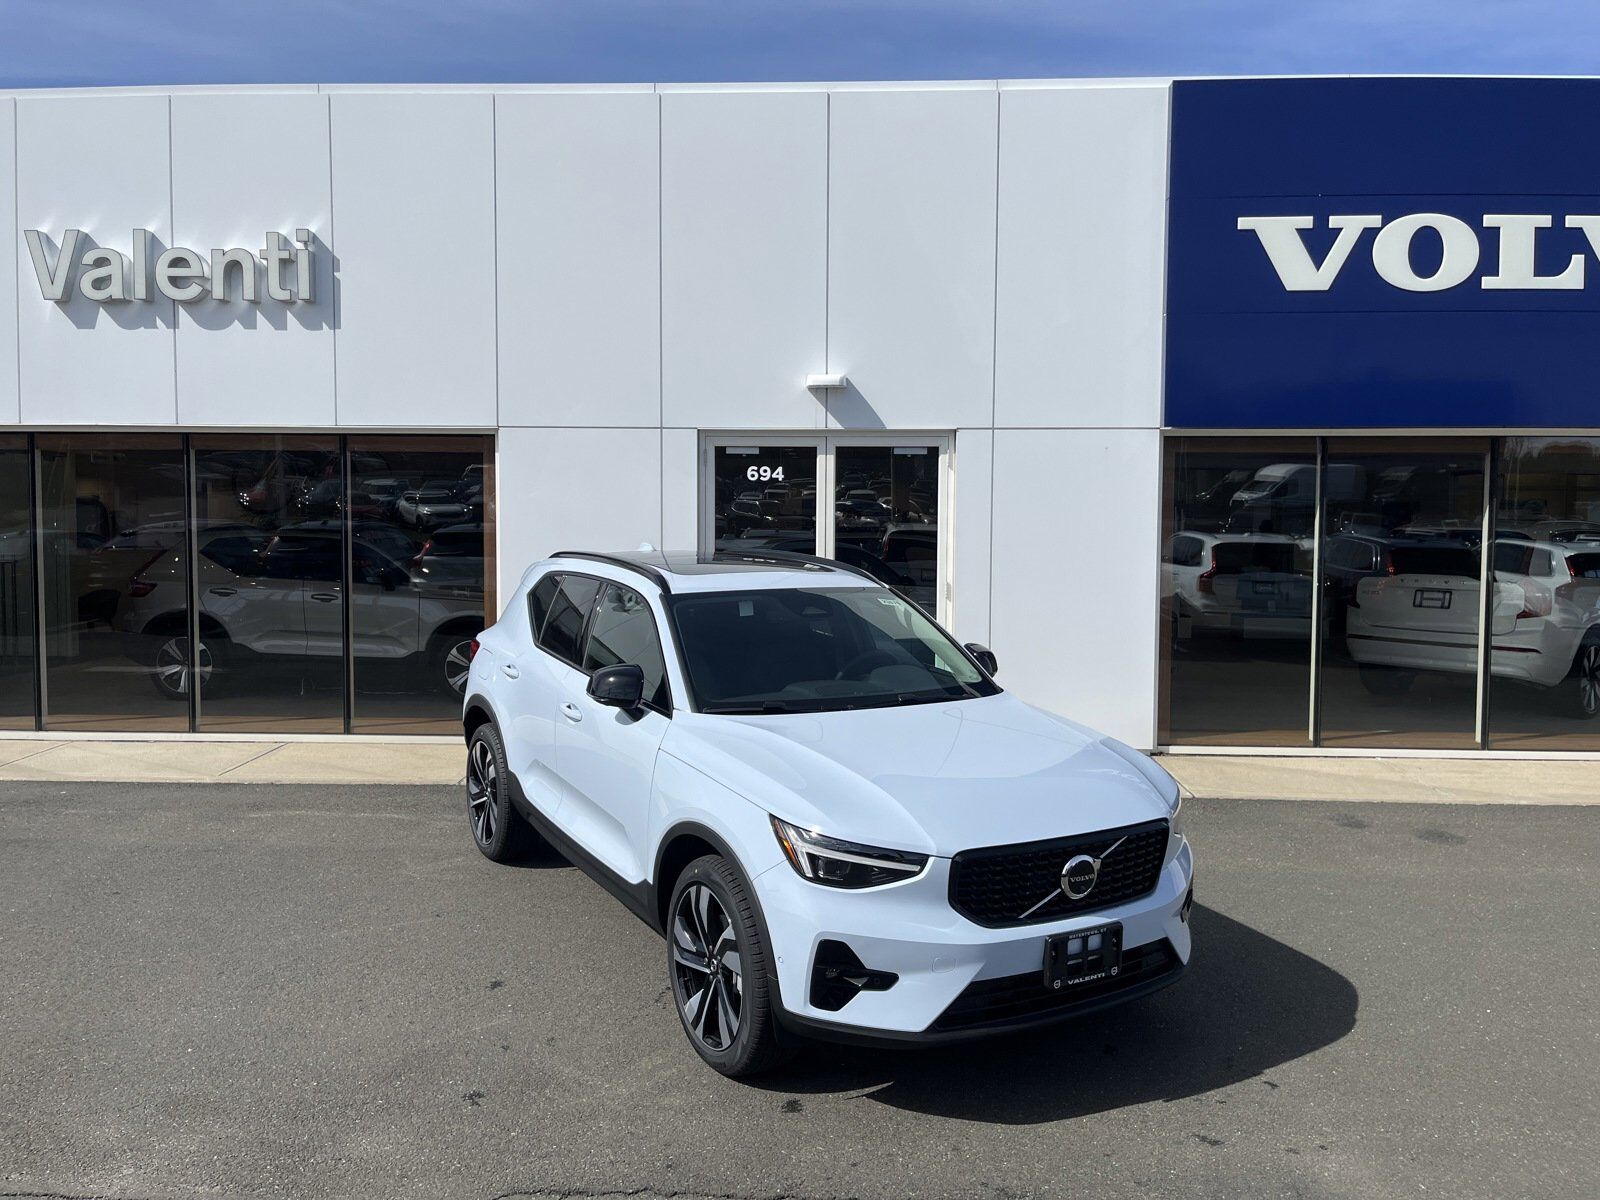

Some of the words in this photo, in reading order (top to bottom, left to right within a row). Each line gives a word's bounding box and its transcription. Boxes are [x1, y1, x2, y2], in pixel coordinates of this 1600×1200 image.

[1237, 213, 1600, 292] VOL
[24, 229, 317, 301] Valenti
[747, 466, 785, 482] 694
[1070, 874, 1095, 882] VOLVO
[1068, 973, 1106, 985] VALENTI
